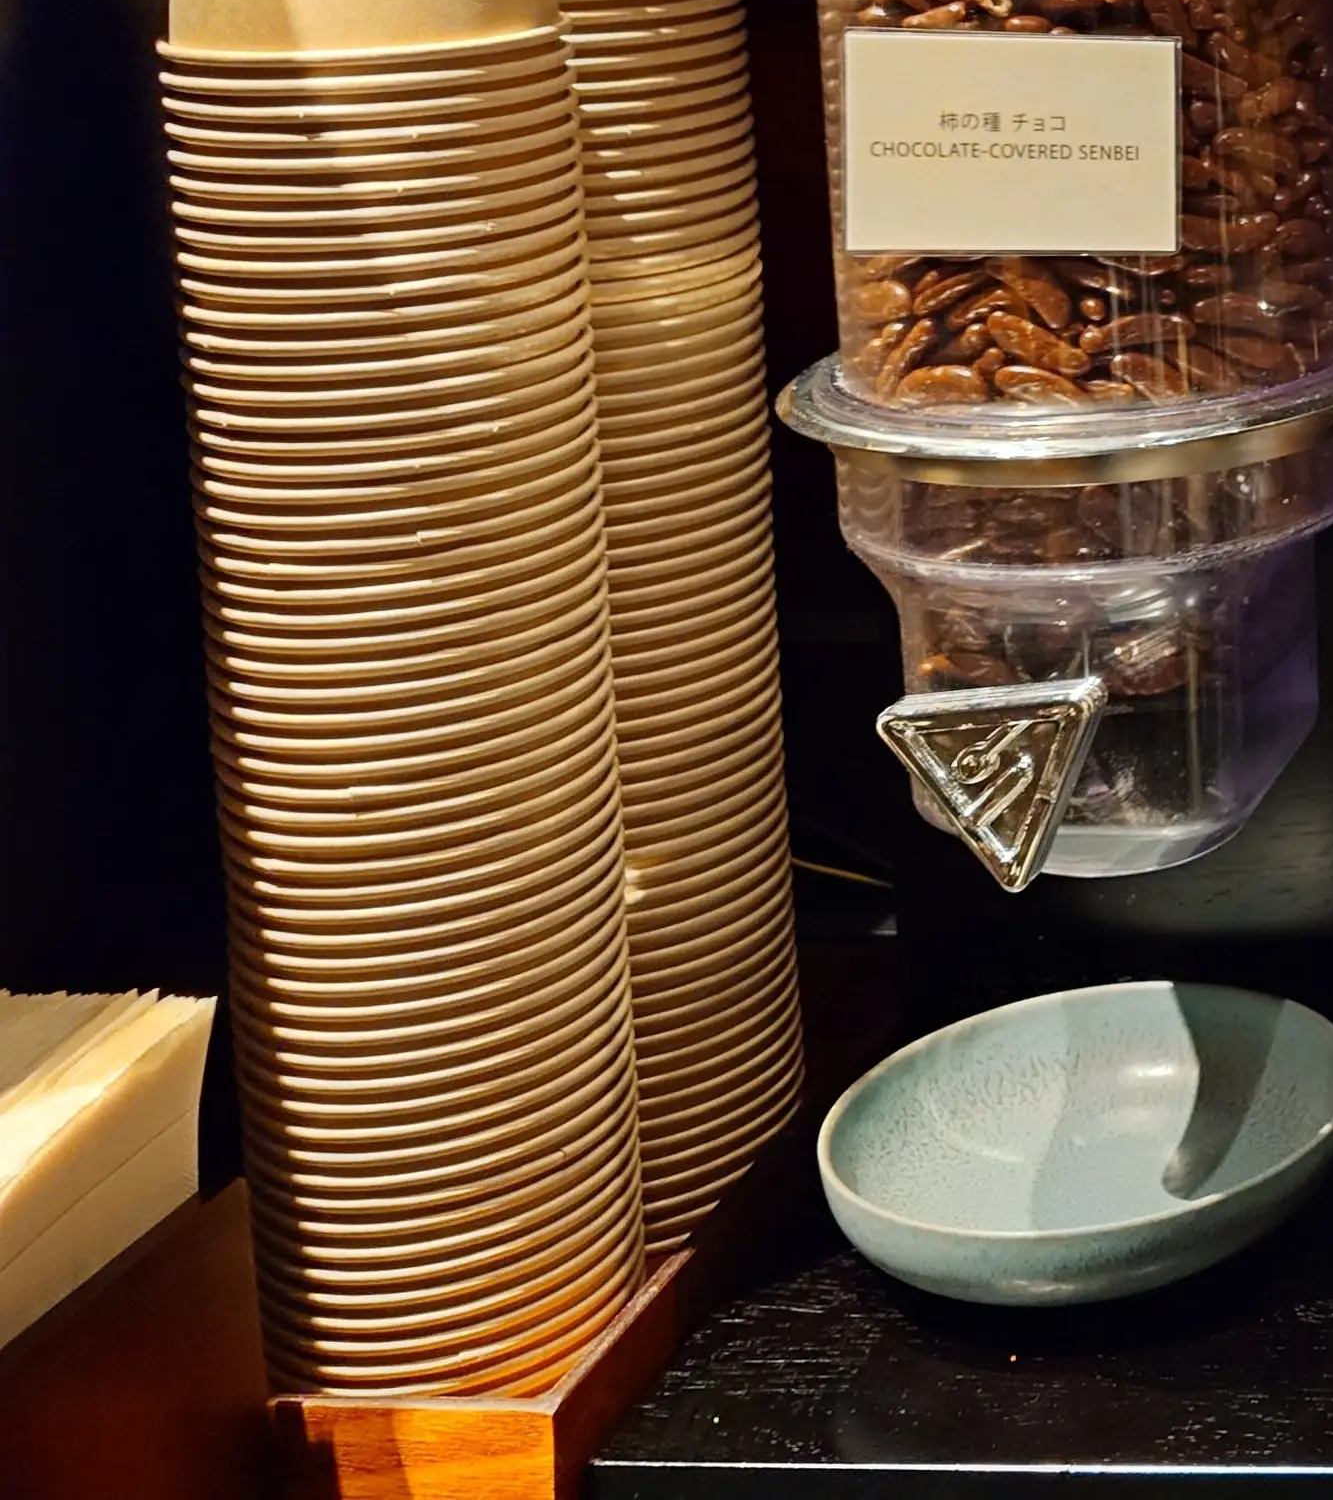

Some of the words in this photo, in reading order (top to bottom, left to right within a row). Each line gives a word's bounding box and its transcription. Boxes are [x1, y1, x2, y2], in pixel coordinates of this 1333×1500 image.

[938, 111, 1002, 133] 柿の種
[1011, 111, 1067, 132] チョコ
[869, 140, 1073, 160] CHOCOLATE-COVERED
[1078, 144, 1140, 161] SENBEI
